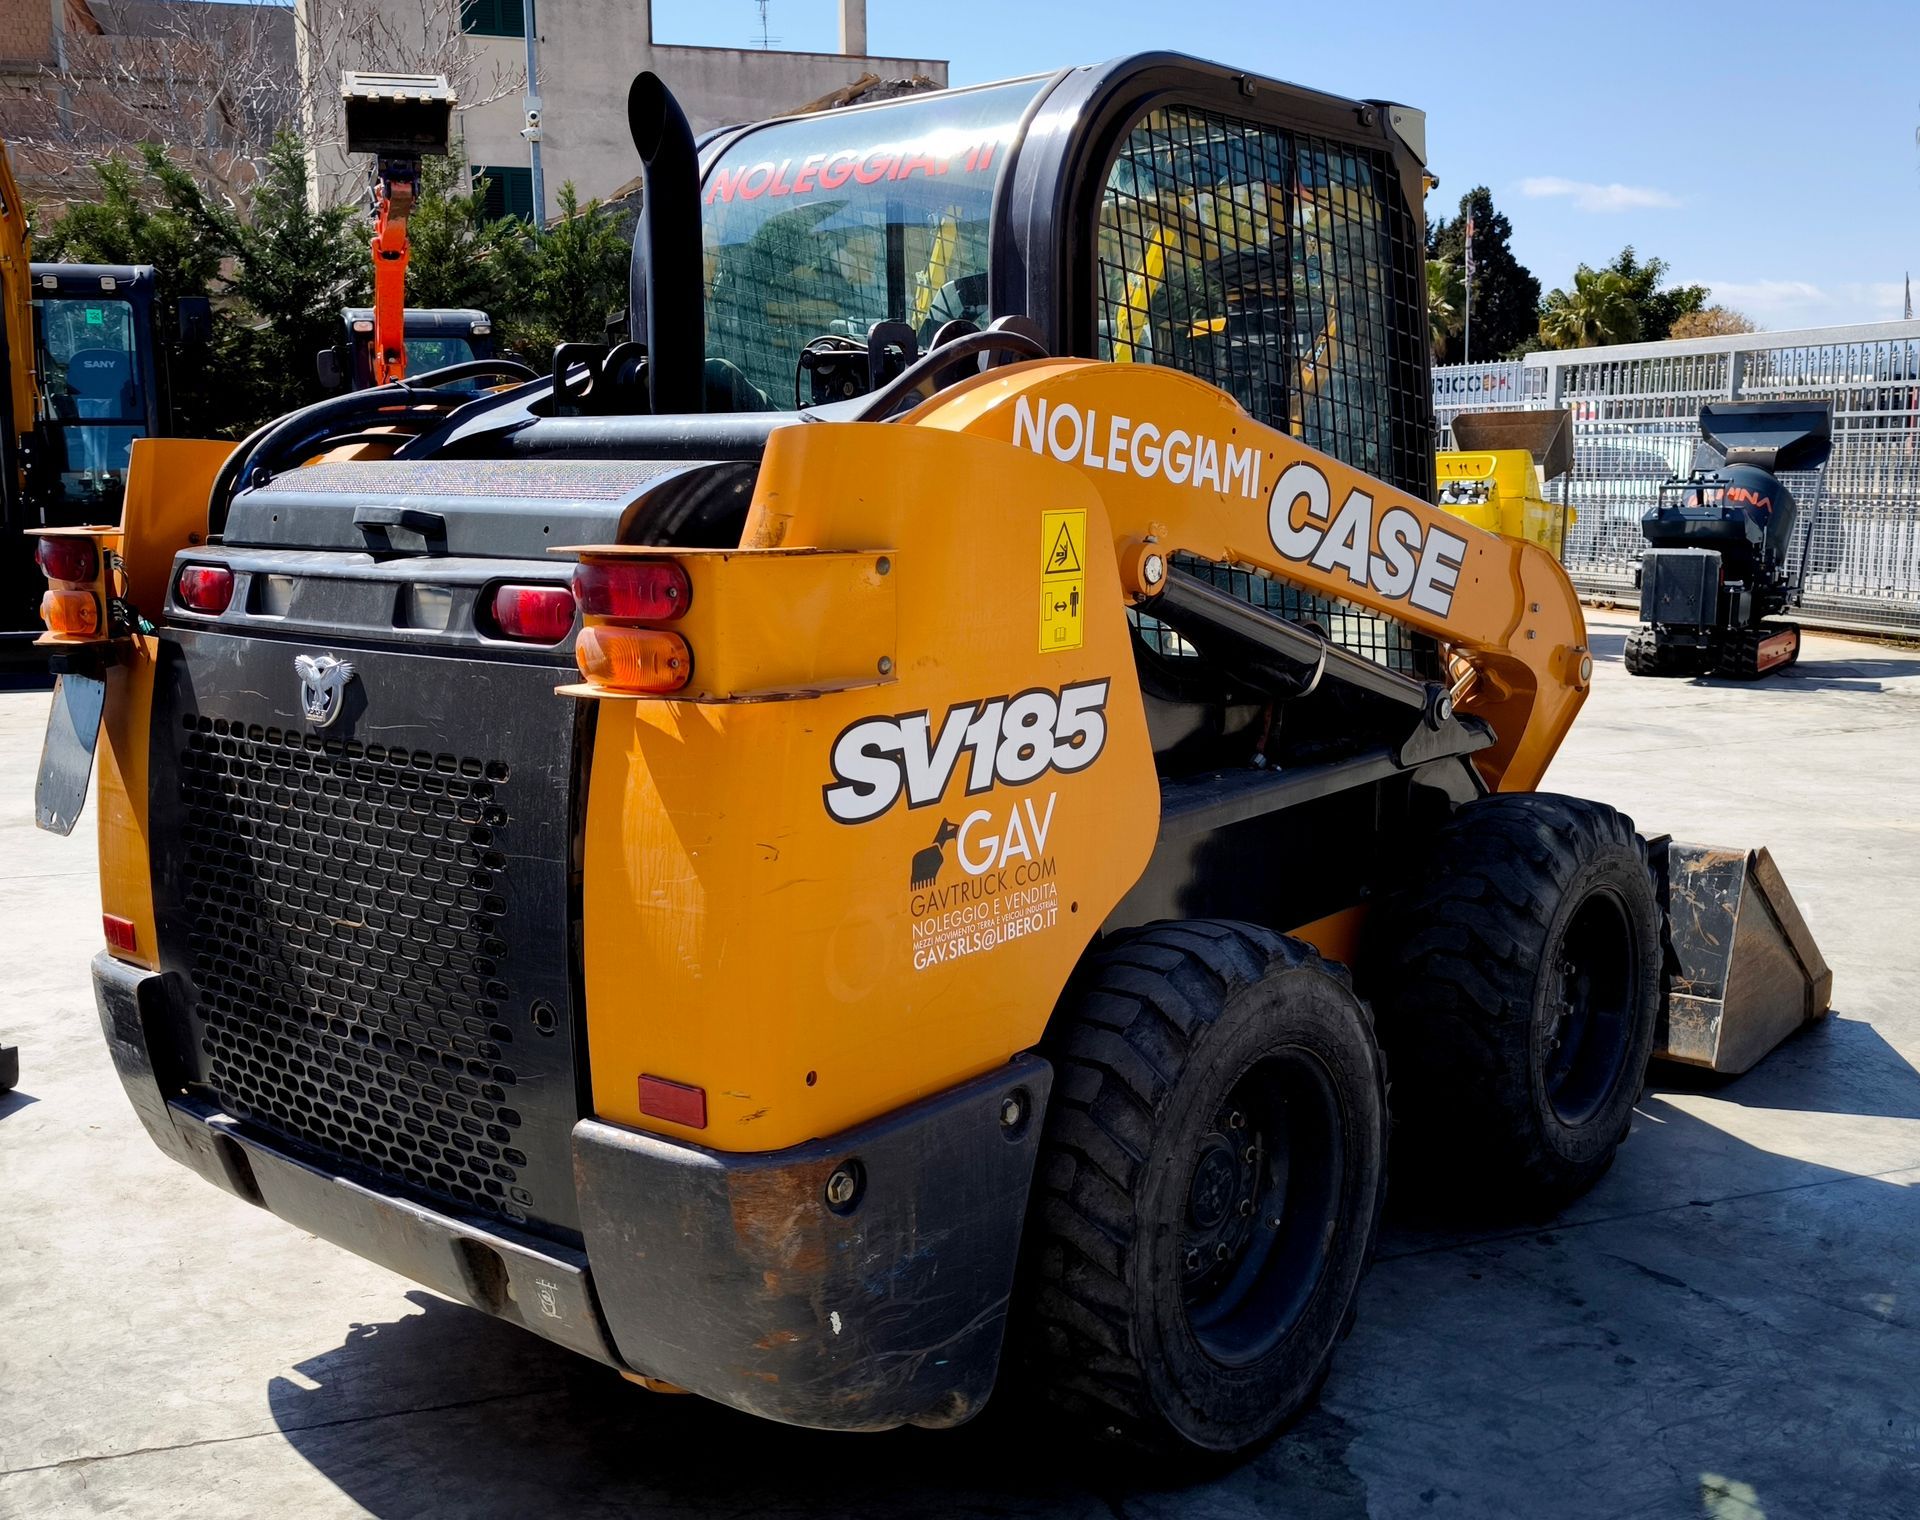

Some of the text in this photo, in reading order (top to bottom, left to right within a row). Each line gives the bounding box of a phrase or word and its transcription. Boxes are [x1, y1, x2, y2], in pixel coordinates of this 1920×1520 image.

[83, 360, 116, 368] SANY
[1012, 394, 1262, 500] NOLEGGIAMI
[1267, 460, 1468, 618] CASE
[822, 676, 1110, 825] SV185
[956, 791, 1057, 876] GAV
[911, 881, 1058, 940] NOLEGGIO E VENDITA
[912, 937, 934, 951] MEZZI
[934, 923, 976, 944] MOVIMENTO
[977, 919, 995, 929] TERRA
[1025, 898, 1058, 914] INDUSTRIALI
[913, 907, 1058, 970] GAV.SRLS@LIBERO.IT
